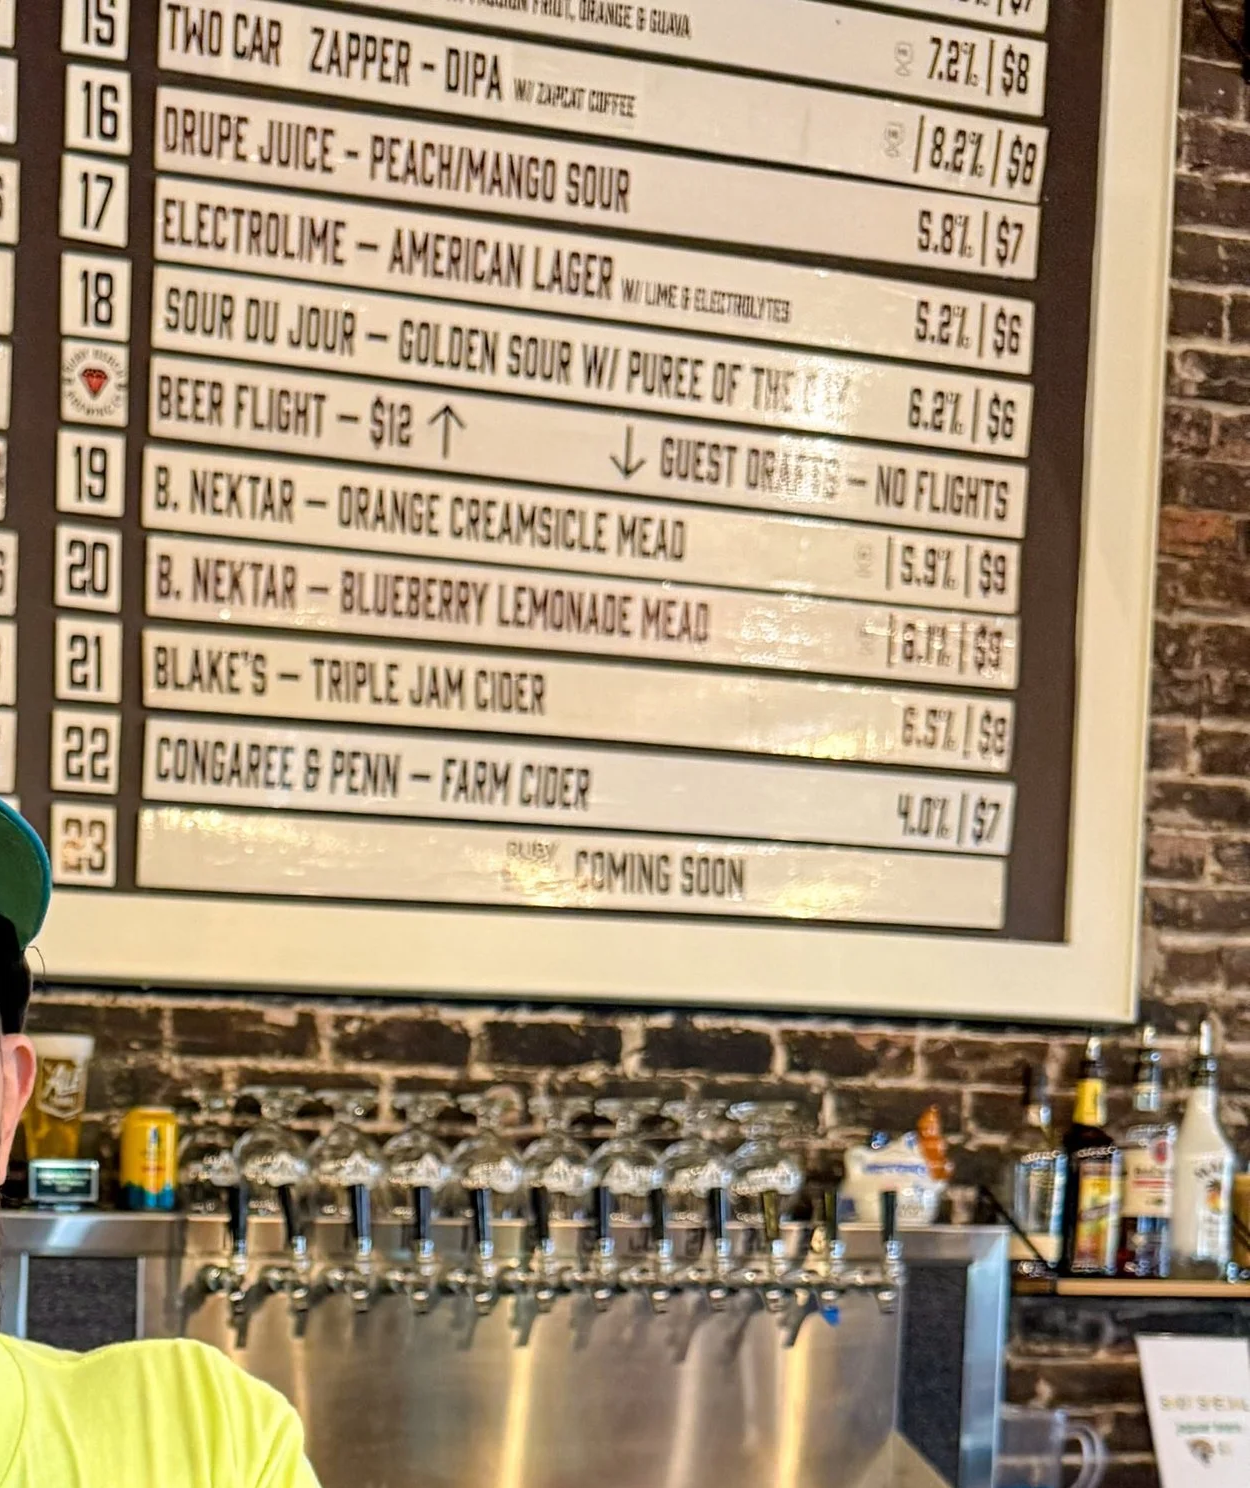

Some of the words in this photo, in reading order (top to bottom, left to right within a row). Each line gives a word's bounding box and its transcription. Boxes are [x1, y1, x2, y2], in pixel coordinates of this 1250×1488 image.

[80, 0, 117, 47] 15
[167, 3, 223, 58] TWO
[232, 13, 282, 67] CAR
[310, 26, 412, 87] ZAPPER
[445, 47, 503, 102] DIPA
[930, 125, 986, 178] 8.2%
[1006, 134, 1037, 190] $8
[927, 37, 979, 86] 7.2%
[1003, 44, 1030, 97] $8
[82, 81, 118, 142] 16
[80, 171, 115, 232] 17
[163, 105, 248, 162] DRUPE
[257, 117, 336, 174] JUICE
[370, 135, 556, 201] PEACH/MANGO
[566, 163, 631, 214] SOUR
[917, 211, 974, 258] 5.8%
[997, 216, 1023, 267] $7
[80, 269, 114, 330] 18
[161, 198, 346, 266] ELECTROLIME
[388, 228, 523, 290] AMERICAN
[533, 246, 614, 301] LAGER
[915, 300, 971, 349] 5.2%
[993, 305, 1022, 358] $6
[164, 286, 234, 341] SOUR
[245, 296, 280, 346] DU
[288, 304, 356, 356] JOUR
[398, 319, 499, 376] GOLDEN
[507, 333, 572, 387] SOUR
[583, 345, 621, 392] W/
[627, 350, 703, 401] PUREE
[712, 361, 743, 406] OF
[988, 392, 1016, 444] $6
[157, 375, 223, 425] BEER
[234, 384, 327, 439] FLIGHT
[369, 396, 414, 450] $12
[73, 446, 107, 504] 19
[660, 436, 738, 484] GUEST
[875, 465, 906, 506] NO
[915, 470, 1008, 521] FLIGHTS
[155, 466, 178, 511] B.
[190, 471, 294, 523] NEKTAR
[338, 485, 439, 537] ORANGE
[449, 495, 607, 552] CREAMSICLE
[617, 516, 687, 561] MEAD
[979, 550, 1006, 597] $9
[67, 538, 109, 597] 20
[155, 555, 179, 600] B.
[192, 556, 296, 611] NEKTAR
[341, 570, 489, 625] BLUEBERRY
[498, 584, 632, 637] LEMONADE
[642, 596, 709, 642] MEAD
[68, 633, 103, 692] 21
[153, 646, 269, 695] BLAKE'S
[312, 657, 400, 705] TRIPLE
[409, 666, 465, 710] JAM
[474, 669, 546, 715] CIDER
[64, 725, 109, 784] 22
[156, 737, 296, 790] CONGAREE
[305, 748, 321, 790] &
[330, 749, 402, 797] PENN
[440, 758, 510, 803] FARM
[520, 764, 591, 810] CIDER
[971, 800, 1001, 848] $7
[576, 850, 670, 894] COMING
[681, 855, 745, 898] SOON
